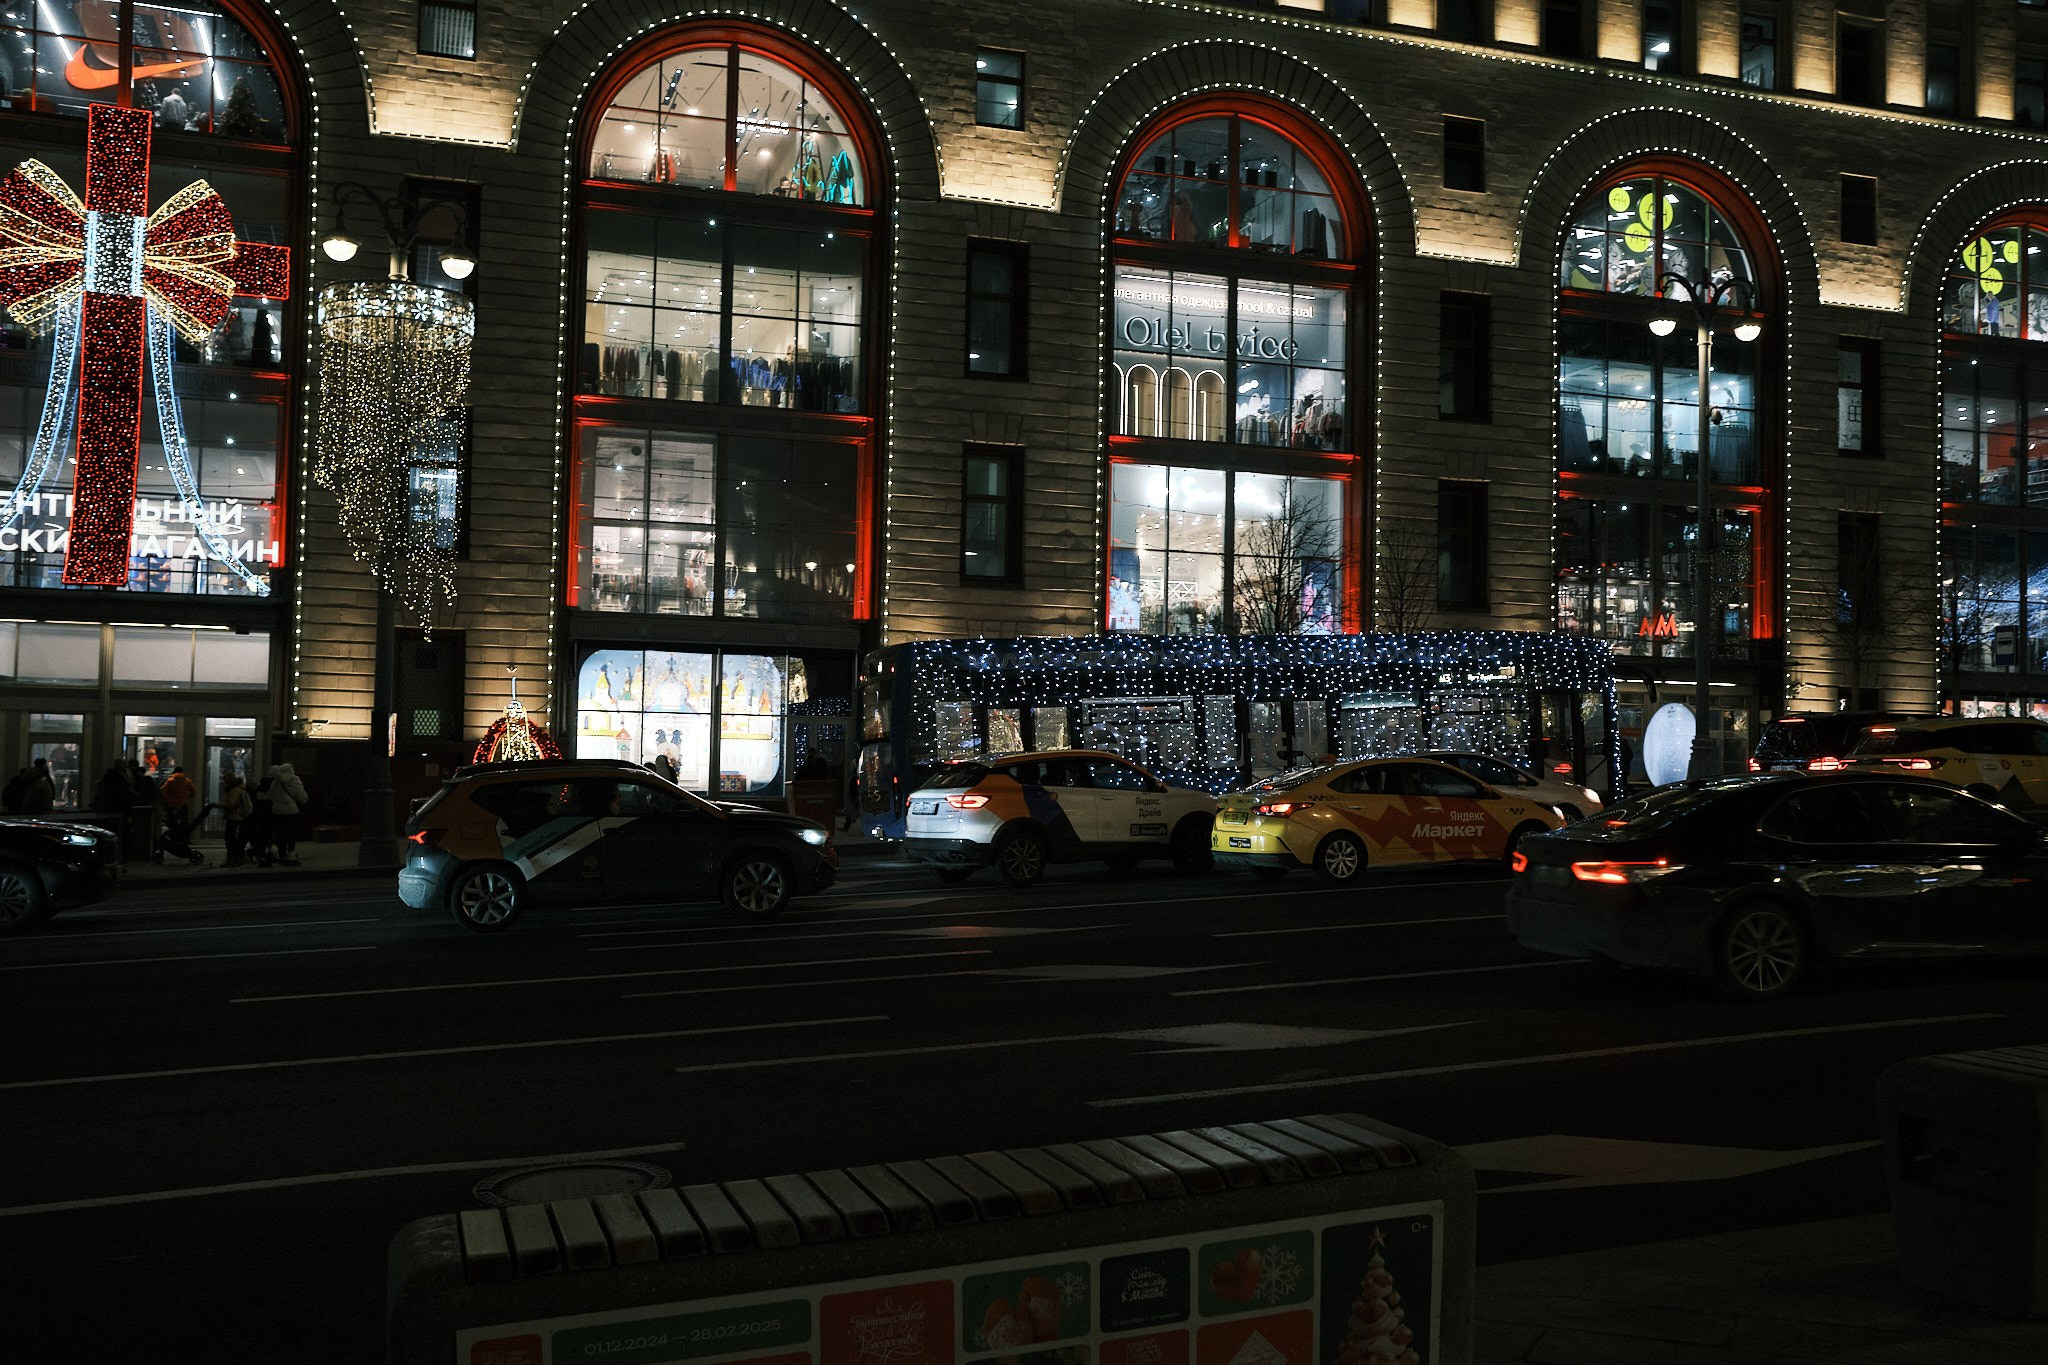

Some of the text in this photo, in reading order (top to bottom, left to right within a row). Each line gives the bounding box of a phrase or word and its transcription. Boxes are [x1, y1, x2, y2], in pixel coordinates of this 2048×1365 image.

[1180, 295, 1224, 310] одежда
[1266, 302, 1275, 314] &
[1277, 305, 1314, 318] casual
[130, 533, 279, 564] АГАЗИН
[1135, 796, 1161, 806] Яндекс
[1138, 807, 1162, 818] Драйв
[1450, 810, 1485, 822] Яндекс
[1411, 823, 1485, 840] Маркет
[584, 1334, 669, 1356] 01.12.2024
[690, 1319, 782, 1342] 28.02.2025
